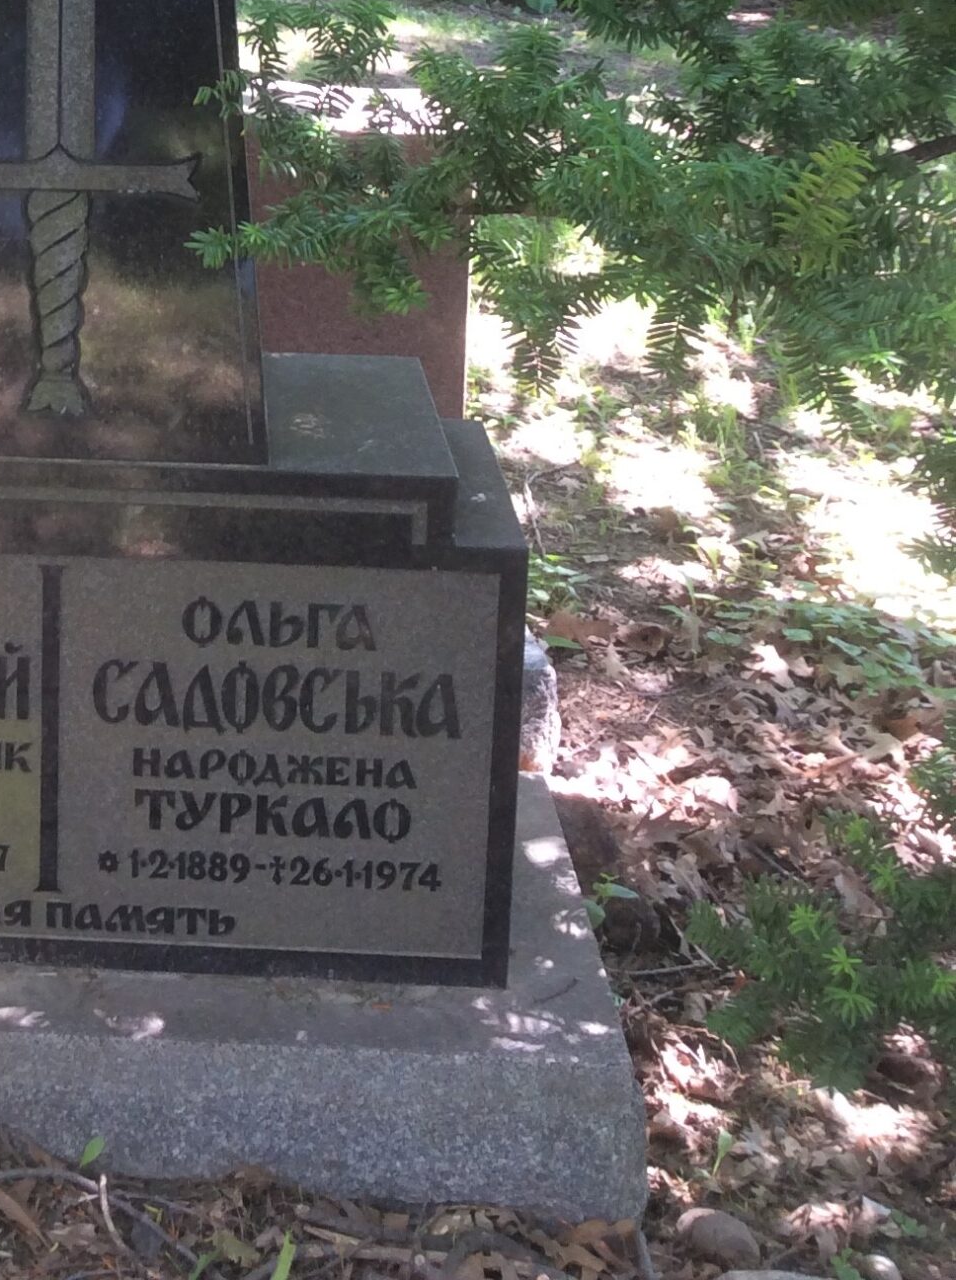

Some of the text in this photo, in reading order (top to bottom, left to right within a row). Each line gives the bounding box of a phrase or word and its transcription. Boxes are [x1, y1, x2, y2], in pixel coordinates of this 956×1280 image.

[182, 596, 377, 651] ОЛЬГА
[92, 658, 462, 739] САДОВСЬКА
[132, 747, 418, 789] НАРОДЖЕНА
[134, 788, 412, 843] ТУРКАЛО
[46, 900, 236, 936] ПАМЯТЬ
